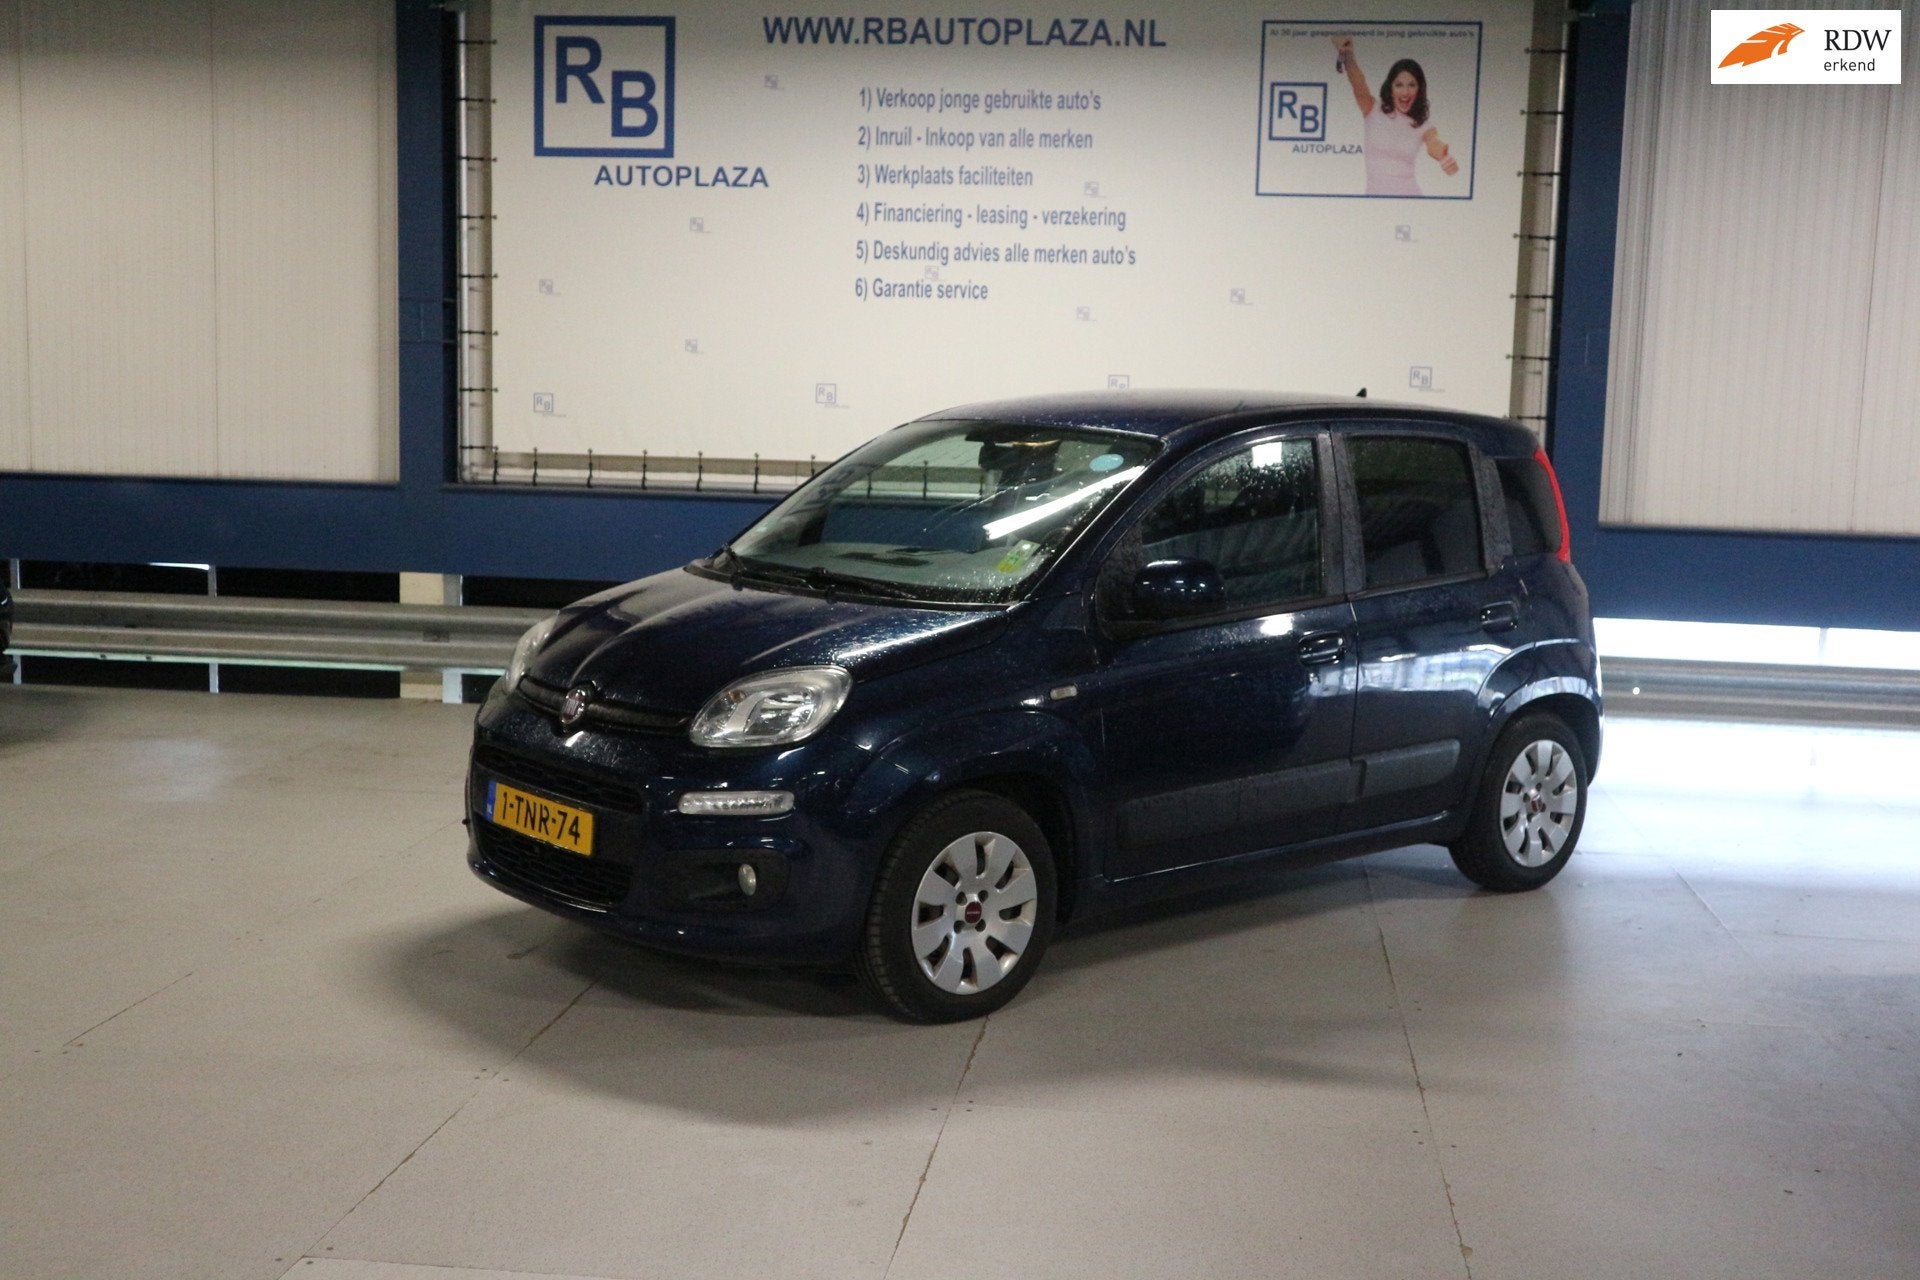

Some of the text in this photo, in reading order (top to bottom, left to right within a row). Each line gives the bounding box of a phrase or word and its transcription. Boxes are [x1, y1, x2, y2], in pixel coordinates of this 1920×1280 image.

[762, 16, 1168, 48] WWW.RBAUTOPLAZA.NL
[859, 87, 1102, 114] 1) Verkoop jonge gebruikte auto's
[858, 126, 871, 150] 2)
[875, 126, 912, 146] Inruil
[925, 127, 975, 151] Inkoop
[979, 131, 1005, 147] van
[1009, 128, 1034, 148] alle
[1039, 129, 1093, 148] merken
[1292, 143, 1363, 154] AUTOPLAZA
[593, 164, 769, 188] AUTOPLAZA
[857, 164, 1033, 189] 3) Werkplaats faciliteiten
[856, 202, 869, 227] 4)
[874, 202, 963, 228] Financiering
[976, 204, 1028, 229] leasing
[1042, 206, 1126, 231] verzekering
[856, 240, 1137, 266] 5) Deskundig advies alle merken auto's
[855, 278, 989, 302] 6) Garantie service
[502, 791, 580, 845] 1-TNR-74
